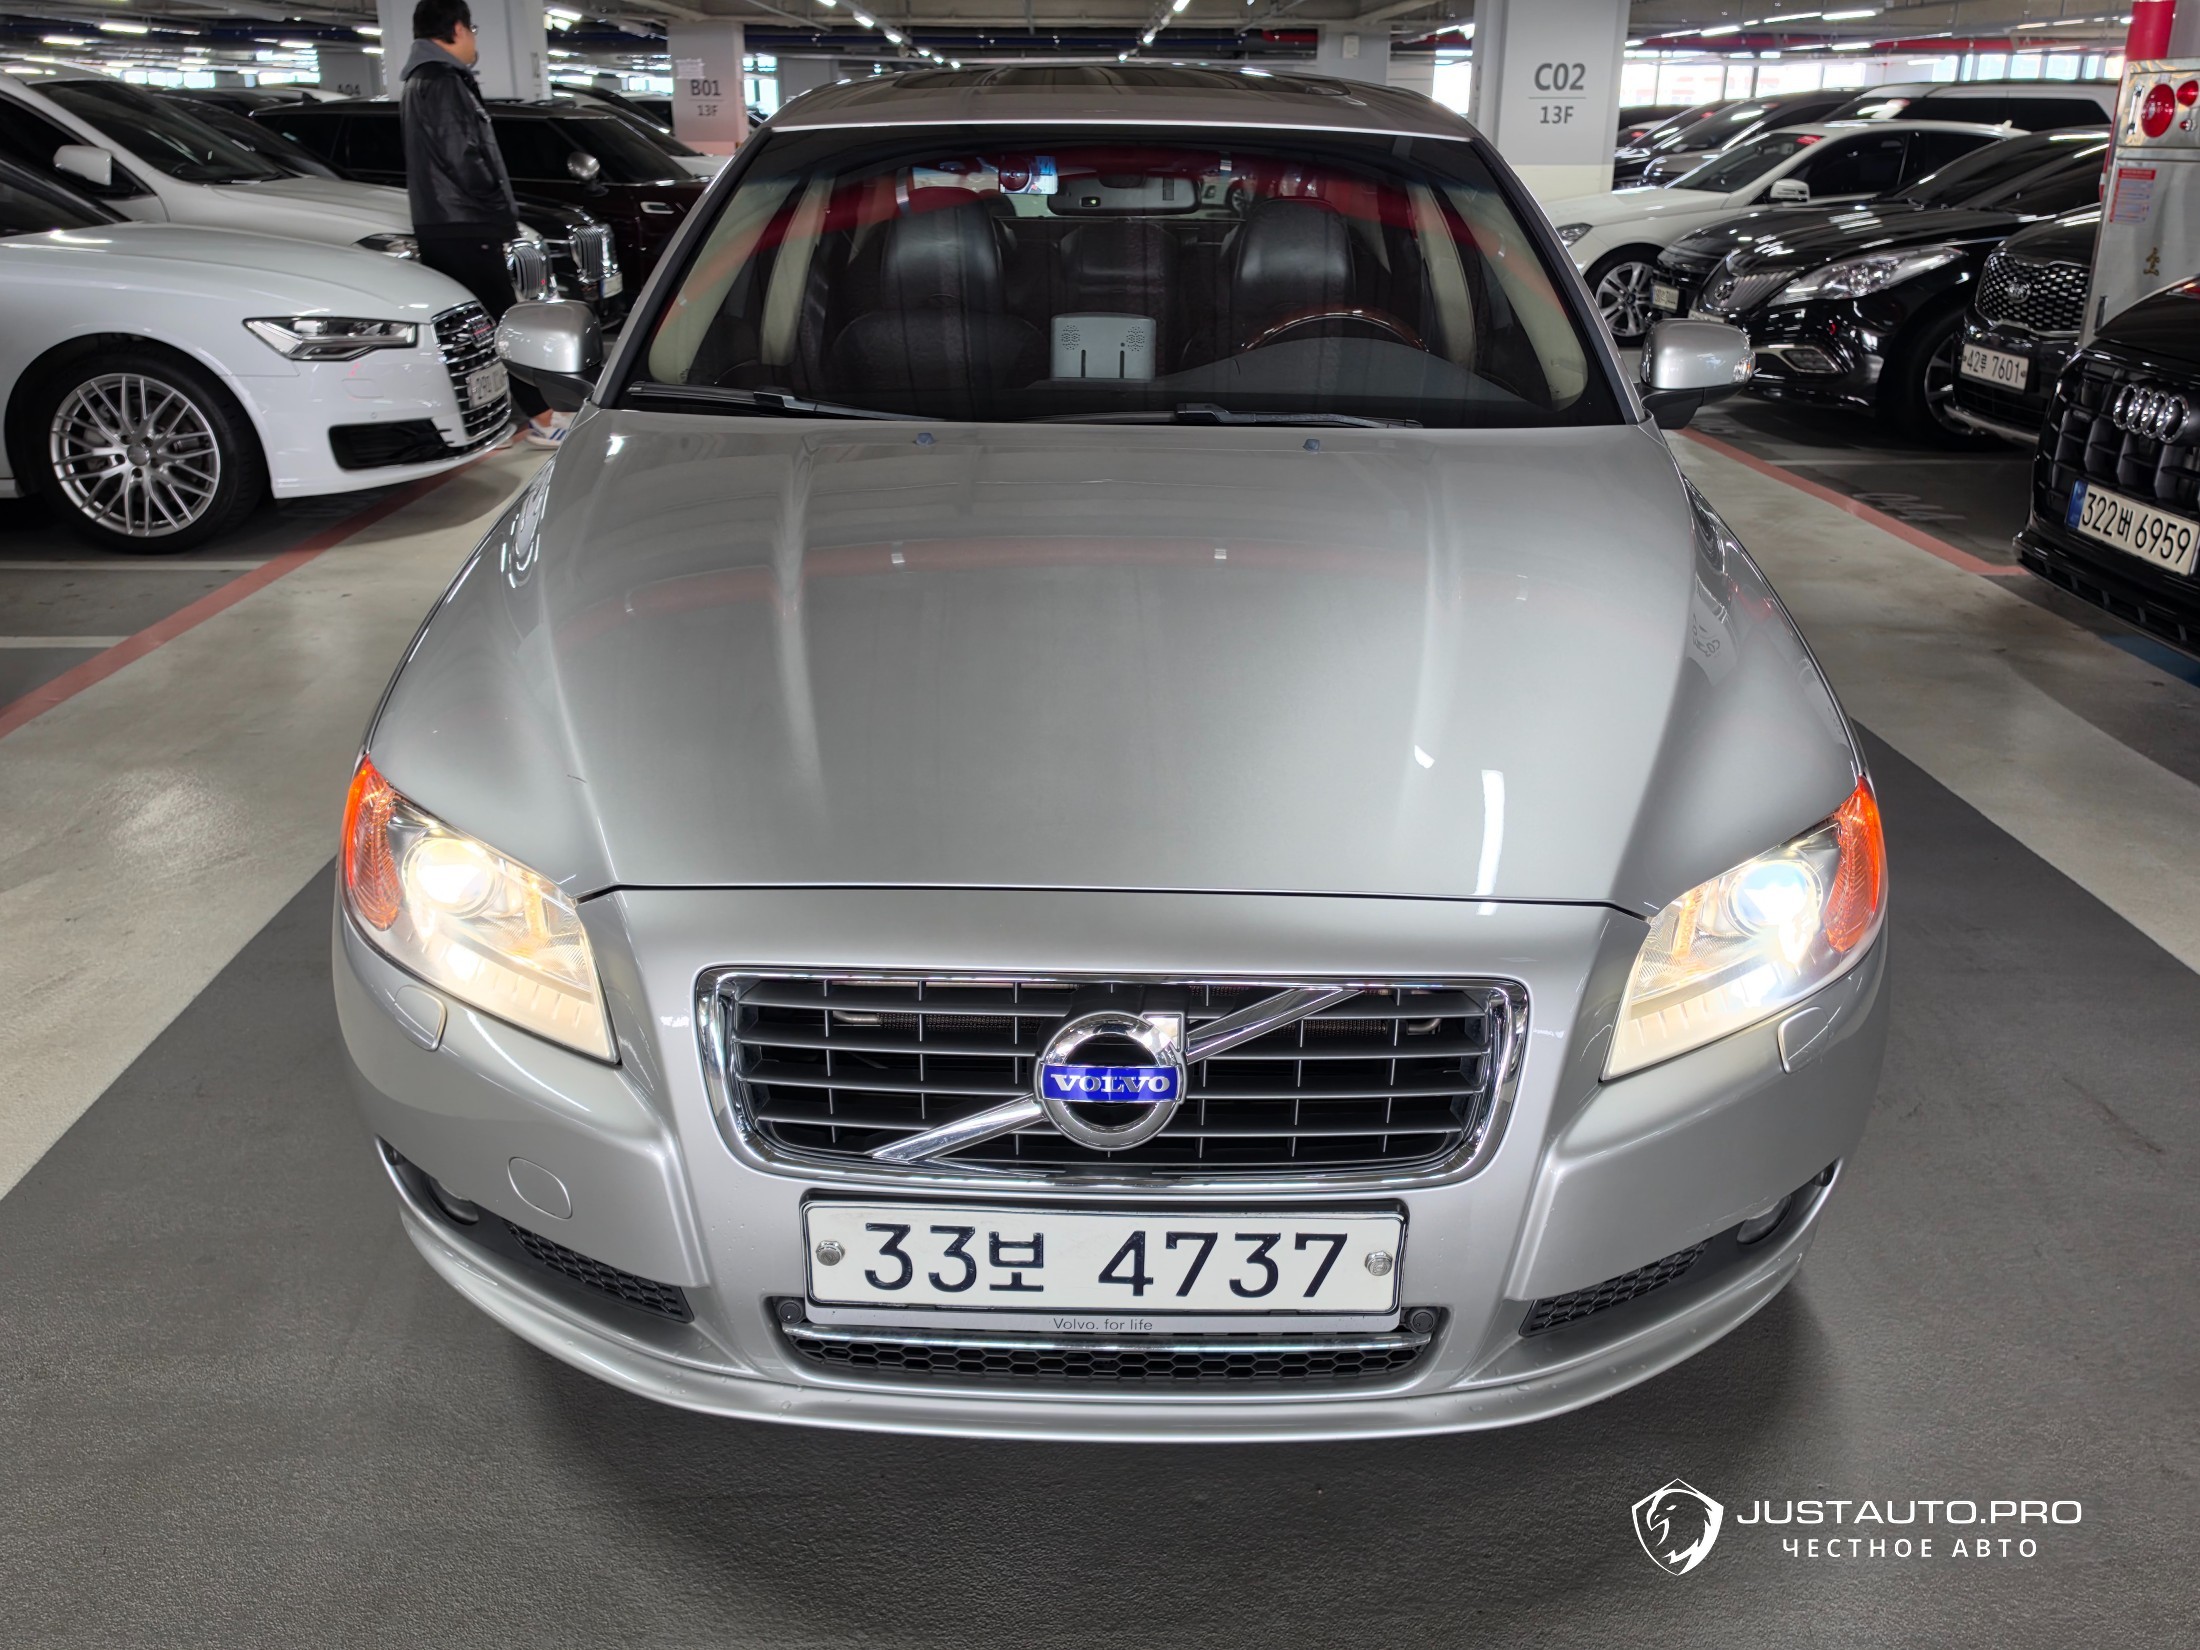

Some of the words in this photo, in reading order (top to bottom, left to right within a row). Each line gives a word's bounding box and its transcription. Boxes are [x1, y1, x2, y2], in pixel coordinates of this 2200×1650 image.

[1534, 62, 1586, 91] C02
[690, 79, 721, 96] B01
[697, 104, 718, 117] 13F
[1540, 105, 1574, 124] 13F
[1966, 349, 1987, 373] 42루
[1992, 355, 2020, 383] 7601
[2082, 491, 2134, 543] 322버
[2135, 513, 2191, 564] 6959
[1050, 1074, 1170, 1093] VOLVO
[864, 1222, 1044, 1293] 33보
[1098, 1230, 1348, 1299] 4737
[1053, 1317, 1099, 1330] Volvo.
[1104, 1318, 1125, 1330] for
[1130, 1318, 1153, 1331] life
